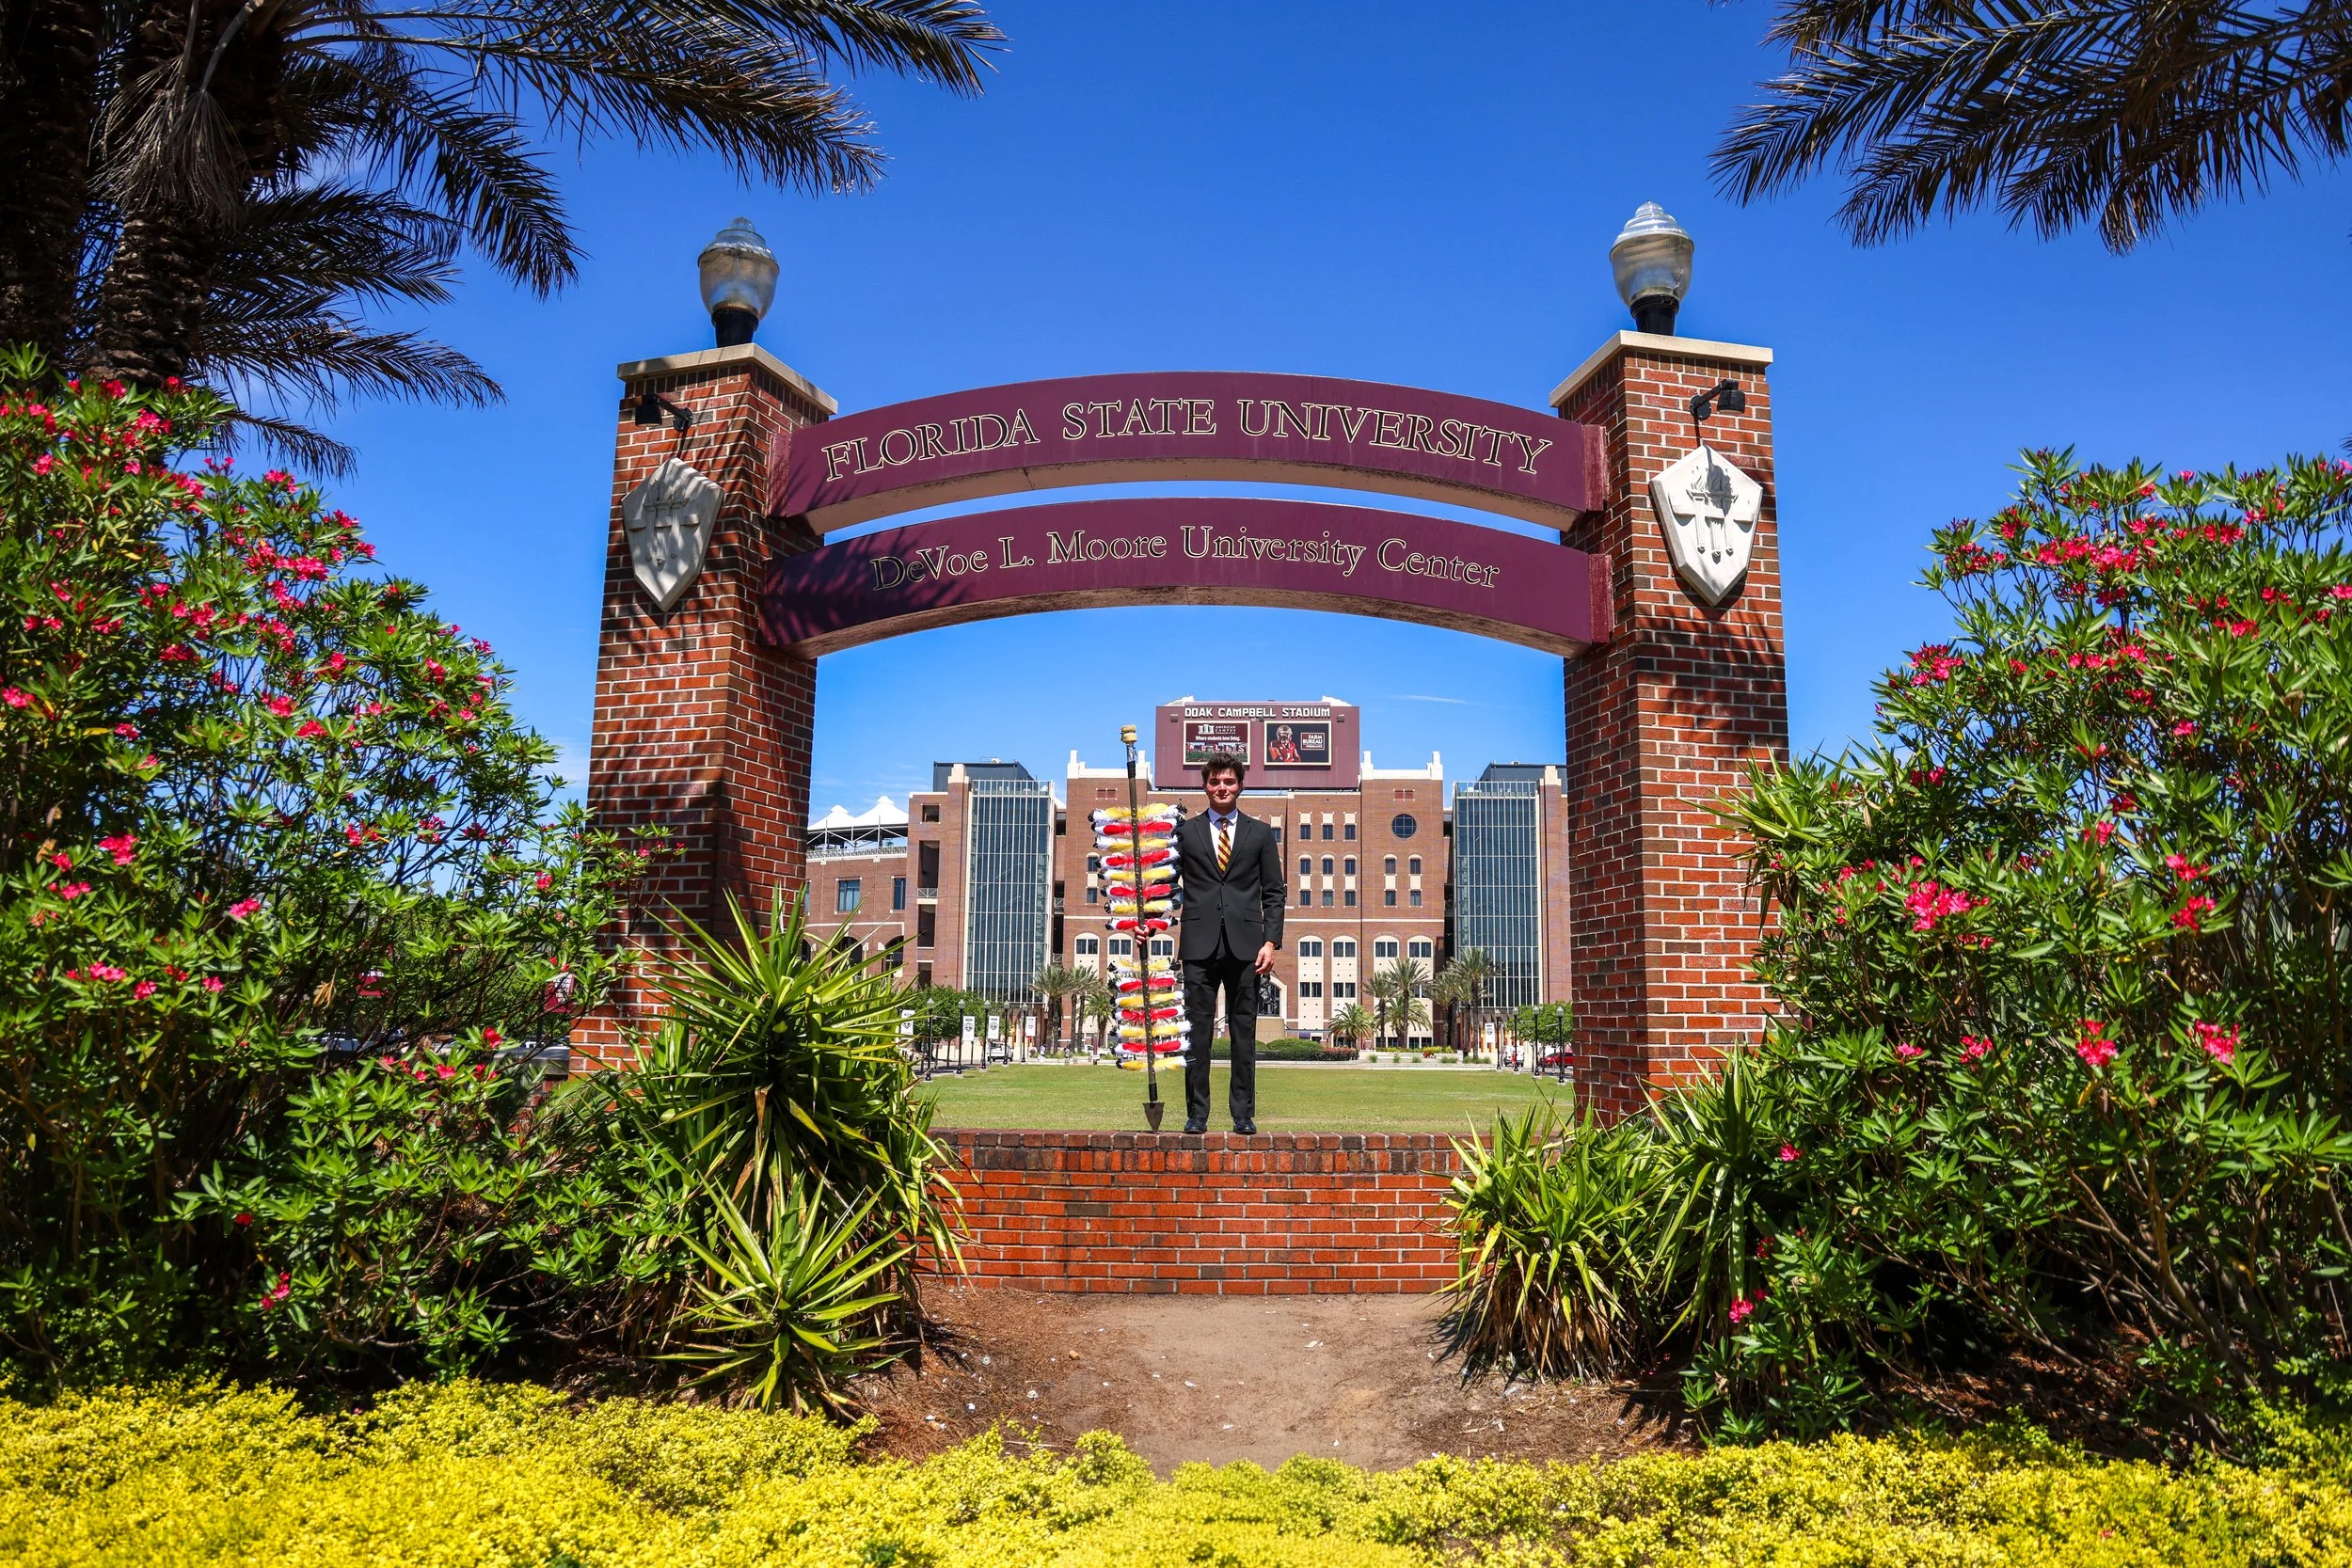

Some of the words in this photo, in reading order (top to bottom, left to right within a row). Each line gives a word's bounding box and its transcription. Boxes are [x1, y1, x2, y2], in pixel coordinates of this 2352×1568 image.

[821, 409, 1041, 482] FLORIDA
[1062, 398, 1217, 440] STATE
[1237, 399, 1552, 474] UNIVERSITY
[871, 544, 989, 592] DeVoe
[998, 537, 1035, 569] L.
[1046, 530, 1167, 563] Moore
[1181, 525, 1366, 577] University
[1377, 537, 1501, 589] Center
[1184, 707, 1213, 717] DOAK
[1217, 707, 1277, 717] CAMPBELL
[1282, 707, 1330, 717] STADIUM
